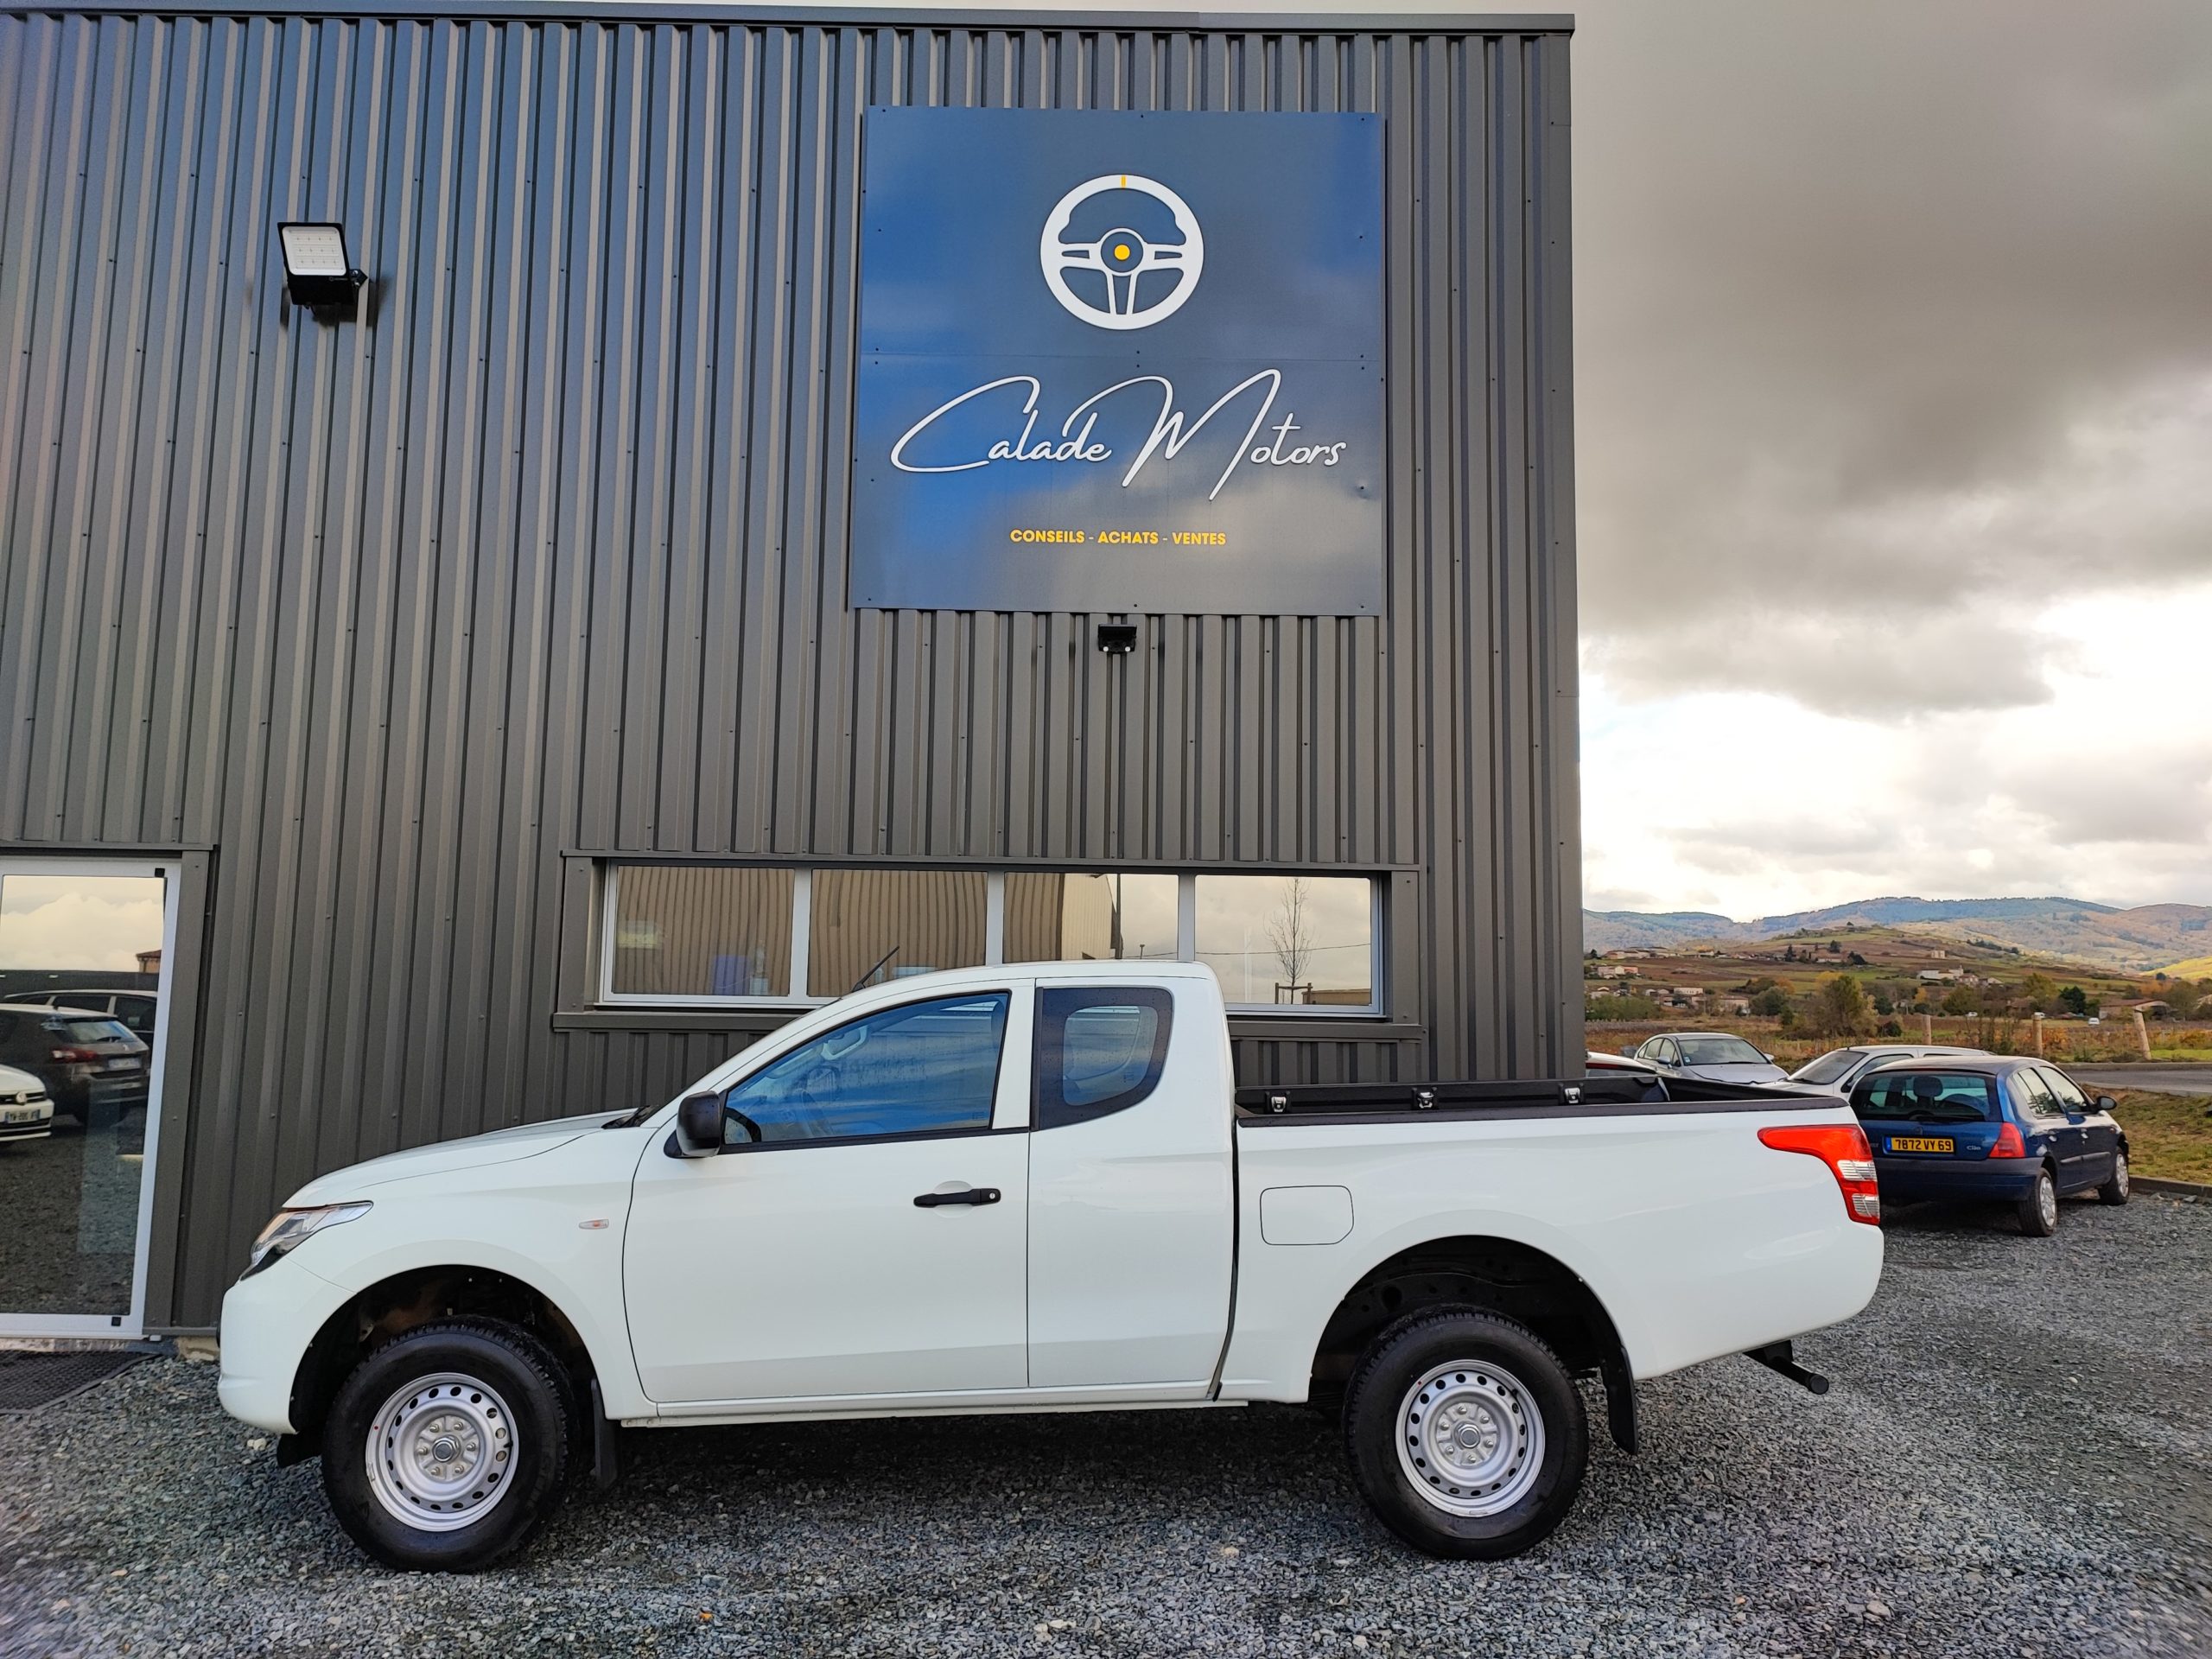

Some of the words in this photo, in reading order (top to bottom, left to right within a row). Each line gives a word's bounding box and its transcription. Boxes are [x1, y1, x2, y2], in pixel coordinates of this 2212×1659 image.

[891, 375, 1112, 474] Calade
[1062, 368, 1347, 501] Motors
[1010, 529, 1085, 544] CONSEILS
[1097, 531, 1159, 545] ACHATS
[1172, 531, 1226, 546] VENTES
[1895, 1139, 1921, 1150] 7872
[1923, 1141, 1936, 1150] VY
[1938, 1141, 1952, 1150] 69
